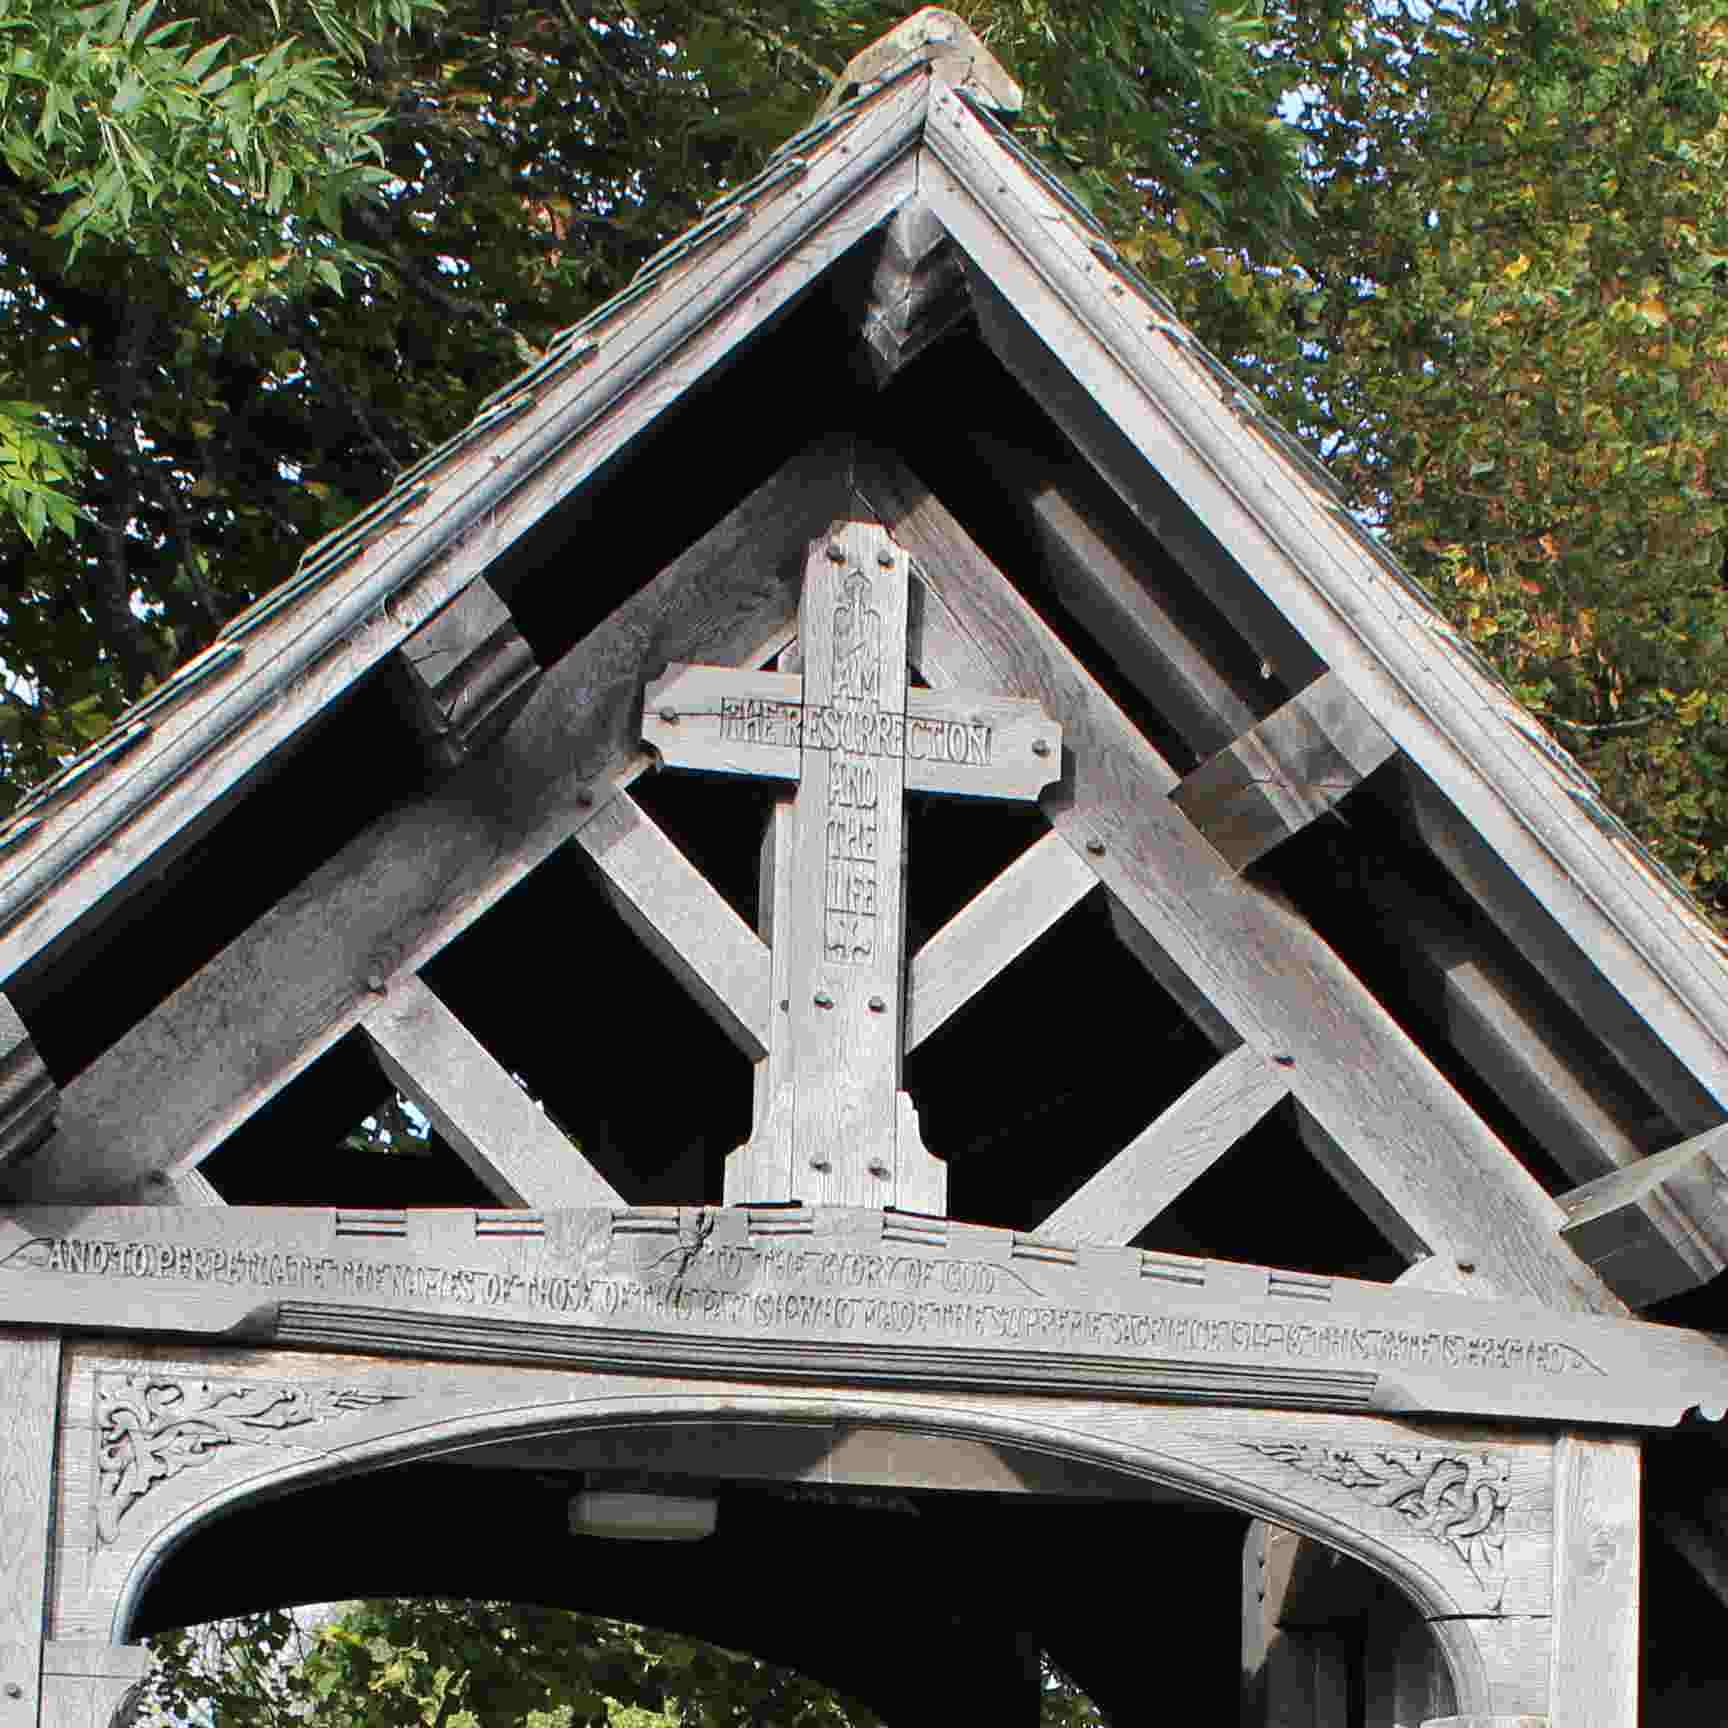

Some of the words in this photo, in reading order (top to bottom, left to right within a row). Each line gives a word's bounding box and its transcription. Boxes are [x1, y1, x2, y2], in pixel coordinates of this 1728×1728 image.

[723, 699, 777, 744] THE
[784, 704, 991, 765] RESURRECTION
[831, 760, 878, 806] AND
[49, 1239, 107, 1274] AND
[118, 1242, 151, 1277] TO
[158, 1246, 333, 1289] PERPETUATE
[944, 1262, 994, 1295] GOD
